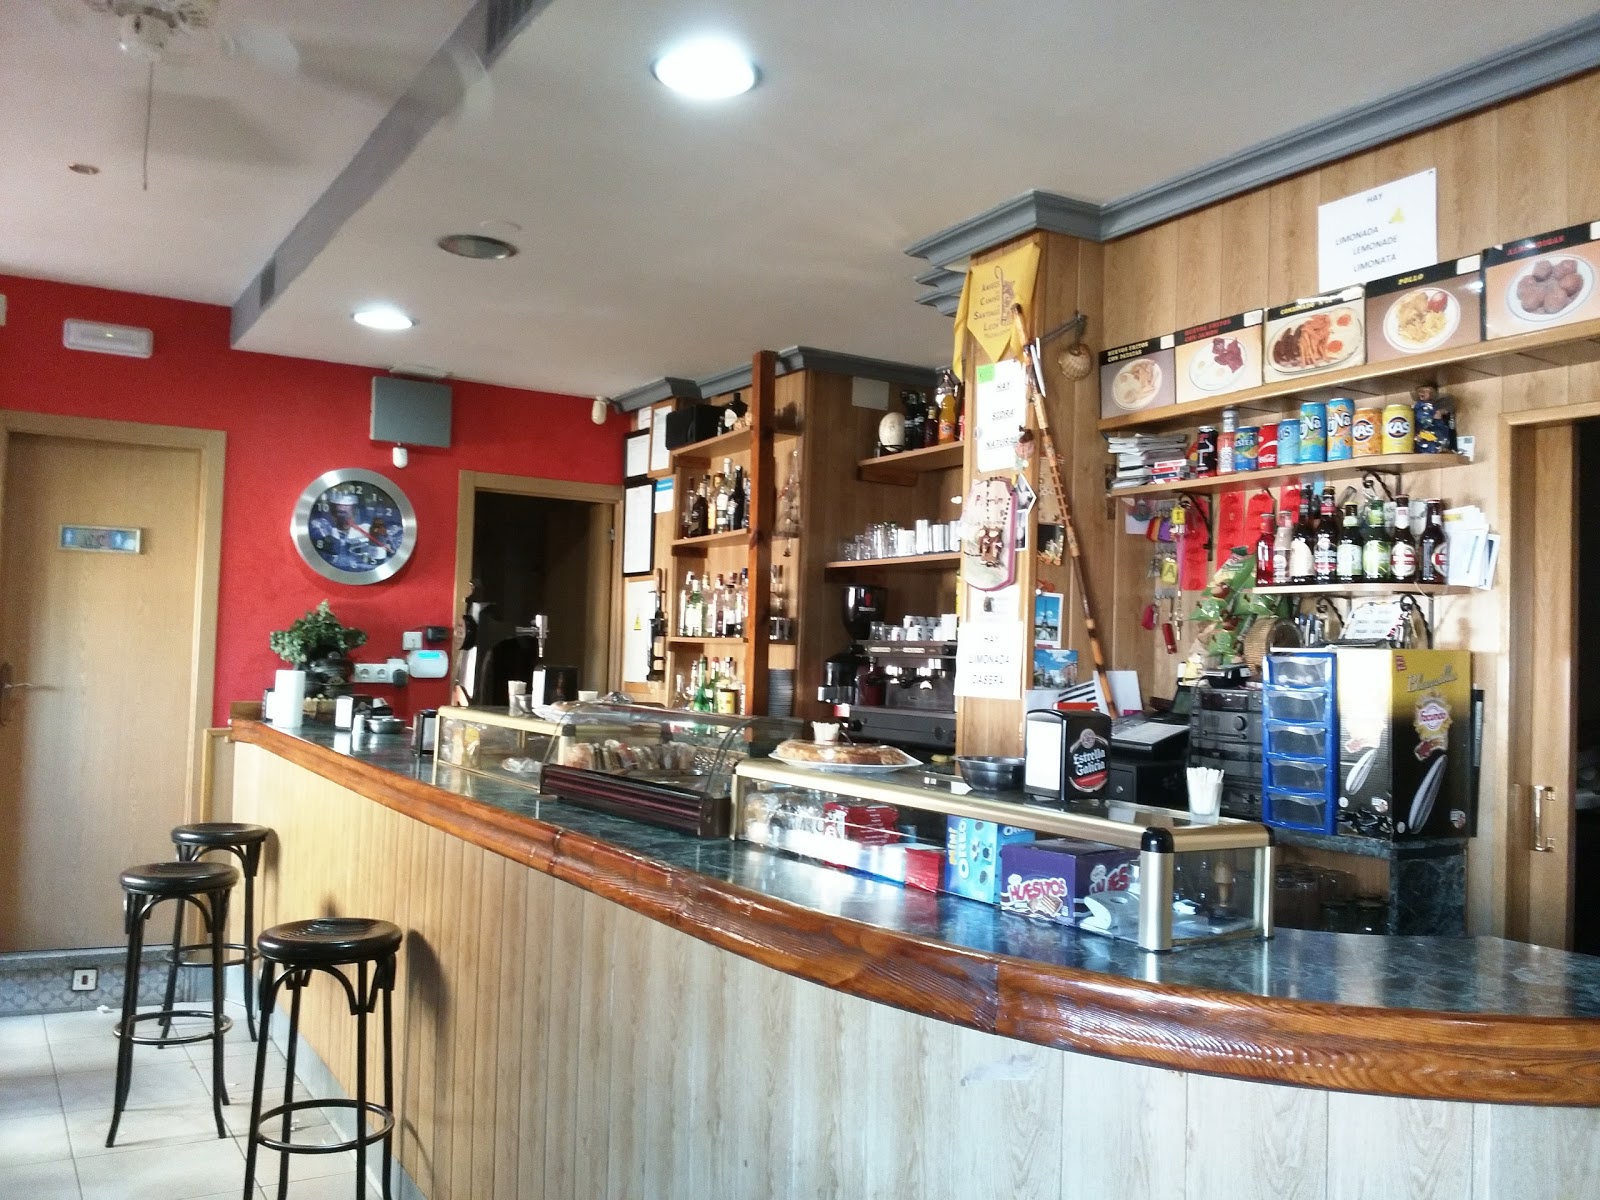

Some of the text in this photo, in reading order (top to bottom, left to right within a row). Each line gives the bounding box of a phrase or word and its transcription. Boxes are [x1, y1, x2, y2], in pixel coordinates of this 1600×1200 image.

[1366, 192, 1383, 204] HAY
[1335, 226, 1379, 246] LIMONADA
[1353, 235, 1398, 255] LEMONADE
[1353, 253, 1397, 272] LIMONATA
[1398, 273, 1425, 285] POLLO
[1073, 748, 1106, 765] Estrella
[1075, 760, 1106, 776] Galicia
[958, 819, 970, 880] OREO
[1010, 877, 1068, 903] HUESITOS
